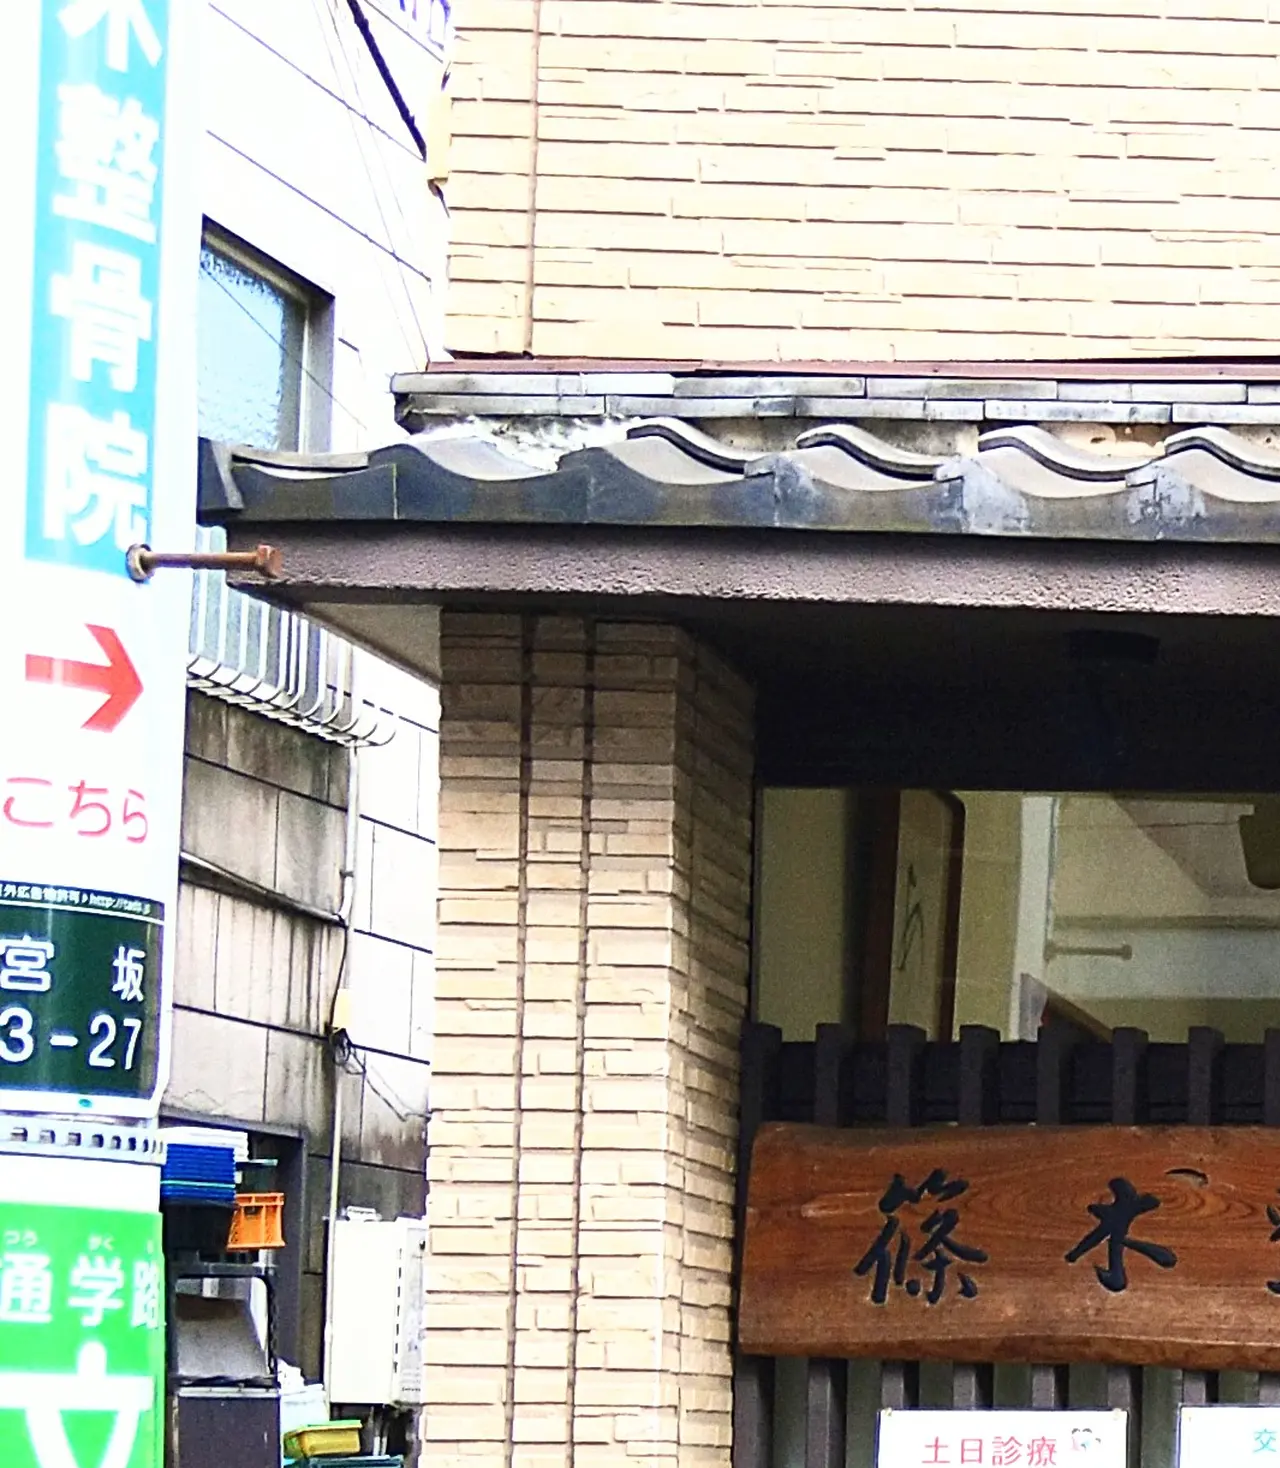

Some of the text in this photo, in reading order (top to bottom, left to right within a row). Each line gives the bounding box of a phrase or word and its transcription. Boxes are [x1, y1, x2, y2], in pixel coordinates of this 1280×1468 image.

[3, 776, 150, 844] こちら
[0, 1006, 143, 1071] 3-27
[921, 1435, 1058, 1467] 土日診療
